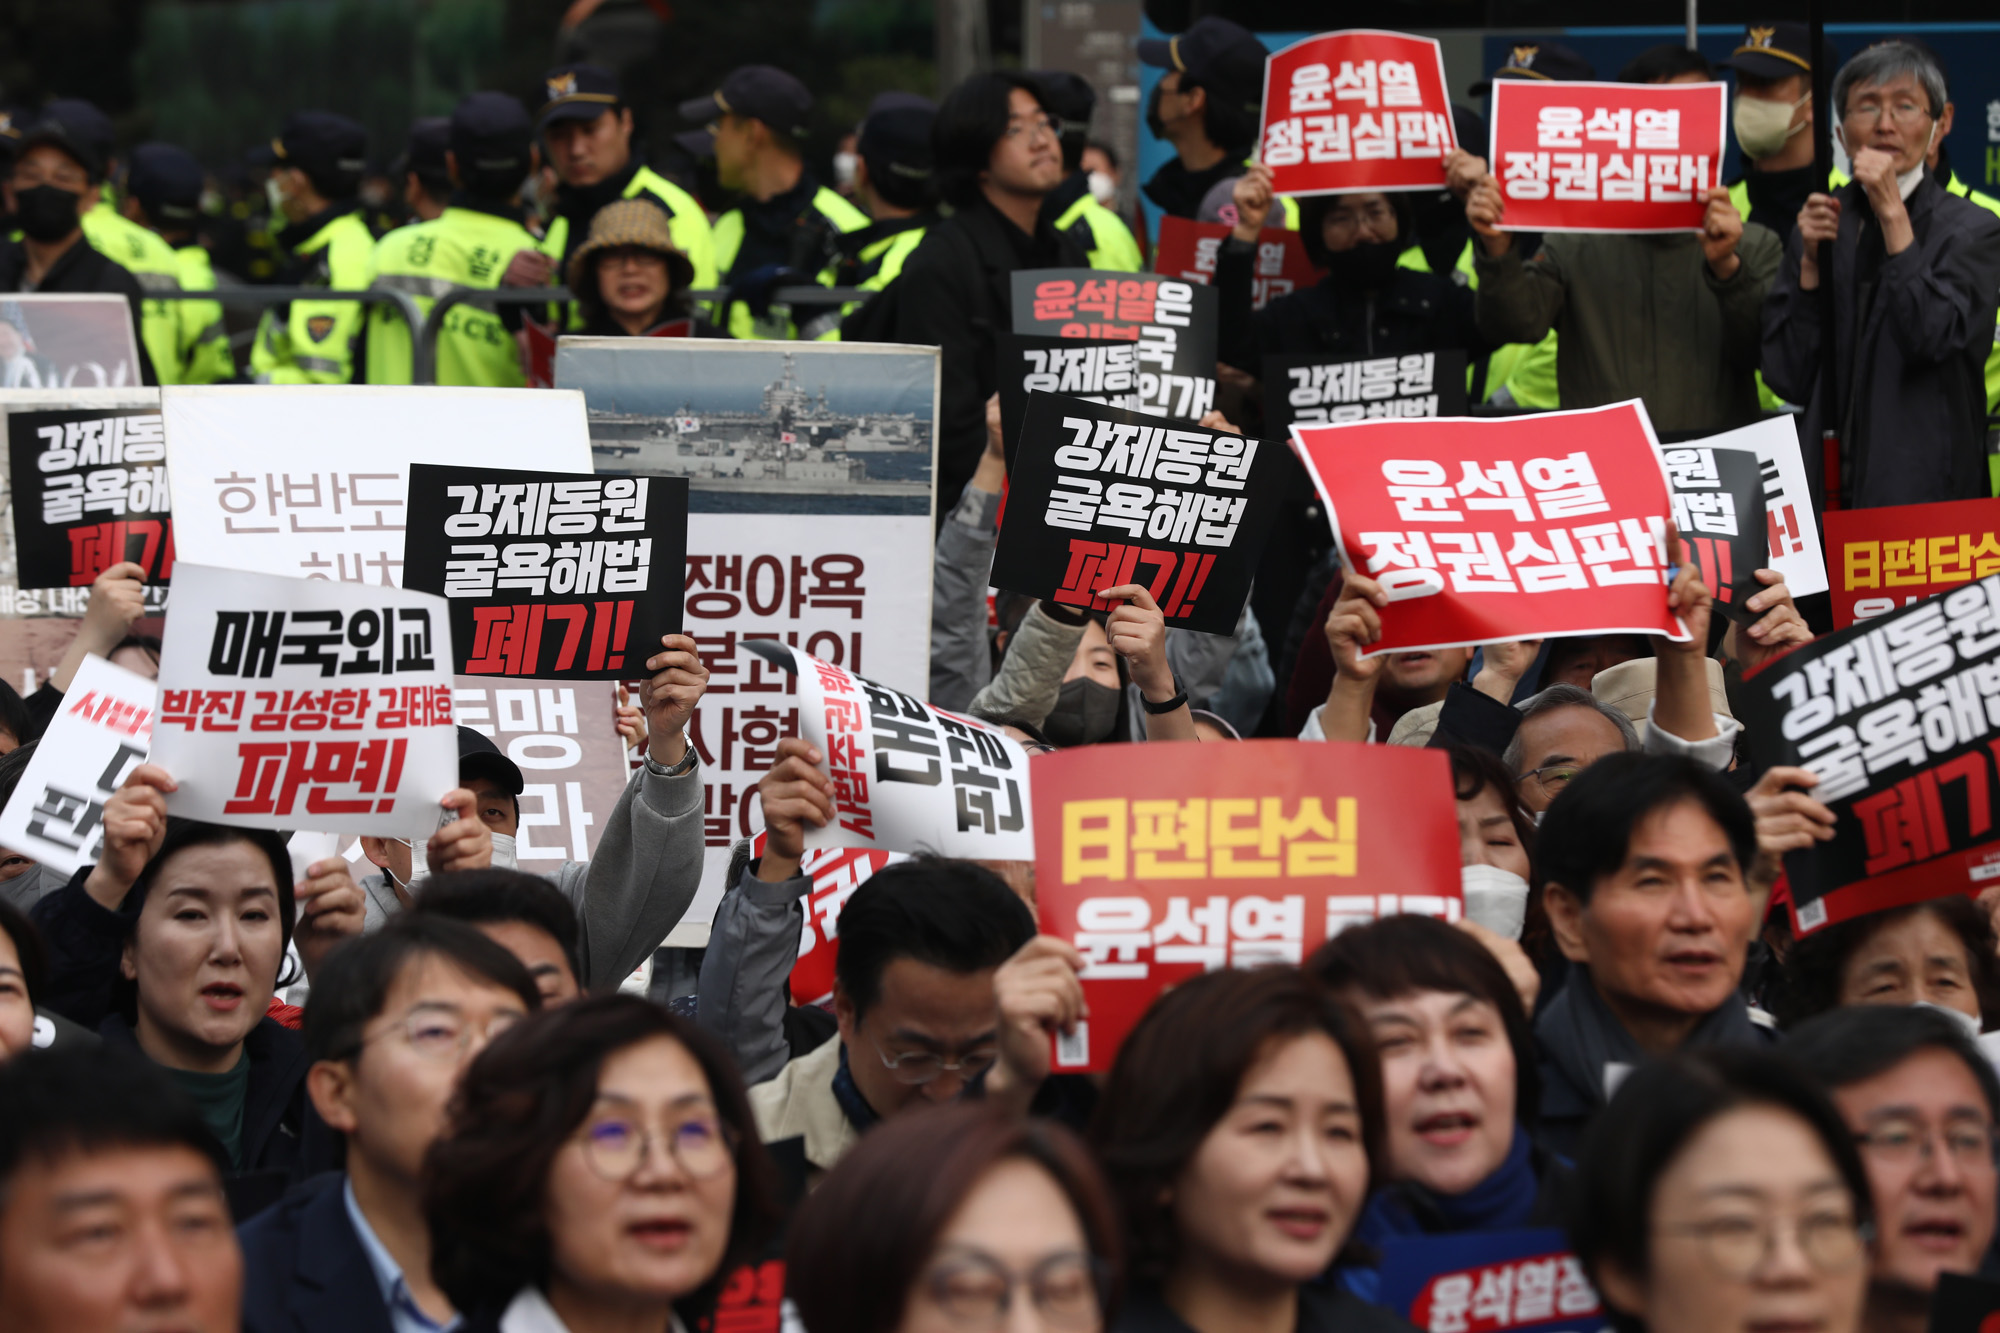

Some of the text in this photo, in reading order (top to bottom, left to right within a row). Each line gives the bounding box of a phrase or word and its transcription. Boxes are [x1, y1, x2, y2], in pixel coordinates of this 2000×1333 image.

[1290, 60, 1422, 113] 윤석열
[1264, 111, 1453, 167] 정권심판!
[1537, 106, 1680, 149] 윤석열
[1504, 151, 1710, 203] 정권심판!
[1033, 279, 1193, 327] 윤석열은
[1023, 344, 1138, 394] 강제동
[1288, 352, 1435, 407] 강제동원
[37, 414, 165, 472] 강제동
[1054, 416, 1259, 490] 강제동원
[1664, 448, 1721, 488] 원
[42, 465, 170, 524] 굴욕해
[214, 471, 406, 534] 한반도
[444, 478, 649, 537] 강제동원
[1044, 475, 1248, 547] 굴욕해법
[1381, 451, 1611, 522] 윤석열
[67, 517, 176, 587] 폐기
[444, 538, 652, 597] 굴욕해법
[1053, 539, 1217, 618] 폐기!
[1359, 515, 1668, 602] 정권심판!
[684, 554, 865, 620] 쟁야욕
[208, 607, 435, 678] 매국외교
[465, 600, 634, 675] 폐기!
[1771, 573, 2000, 741] 강제동원
[161, 684, 453, 732] 박진 김성한 김태효
[223, 738, 408, 816] 파면!
[1062, 797, 1358, 885] 日편단심
[1074, 894, 1305, 980] 윤석열
